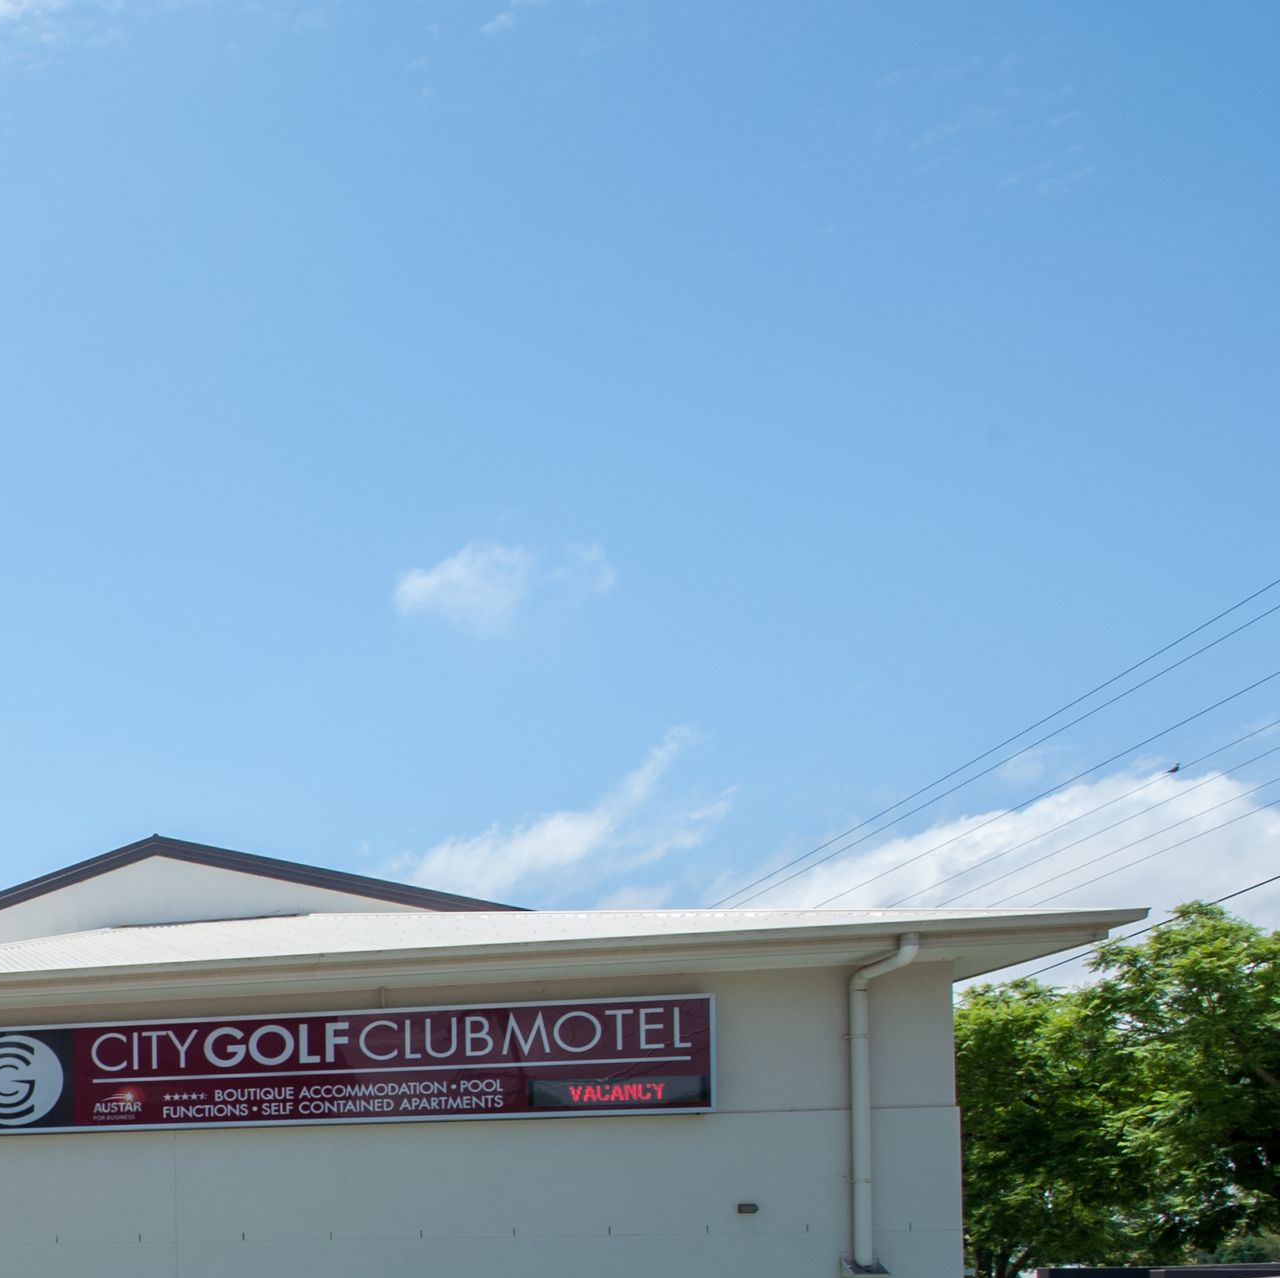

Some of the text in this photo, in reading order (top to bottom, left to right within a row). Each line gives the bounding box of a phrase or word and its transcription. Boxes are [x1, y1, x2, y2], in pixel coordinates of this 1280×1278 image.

[203, 1022, 349, 1068] GOLF
[358, 1015, 494, 1061] CLUB
[501, 1006, 692, 1056] MOTEL
[214, 1079, 503, 1102] BOUTIQUE ACCOMMODATION POOL
[569, 1083, 665, 1103] VACANCY
[93, 1101, 142, 1114] AUSTAR
[162, 1095, 503, 1119] FUNCTIONS SELF CONTAINED APARTMENTS
